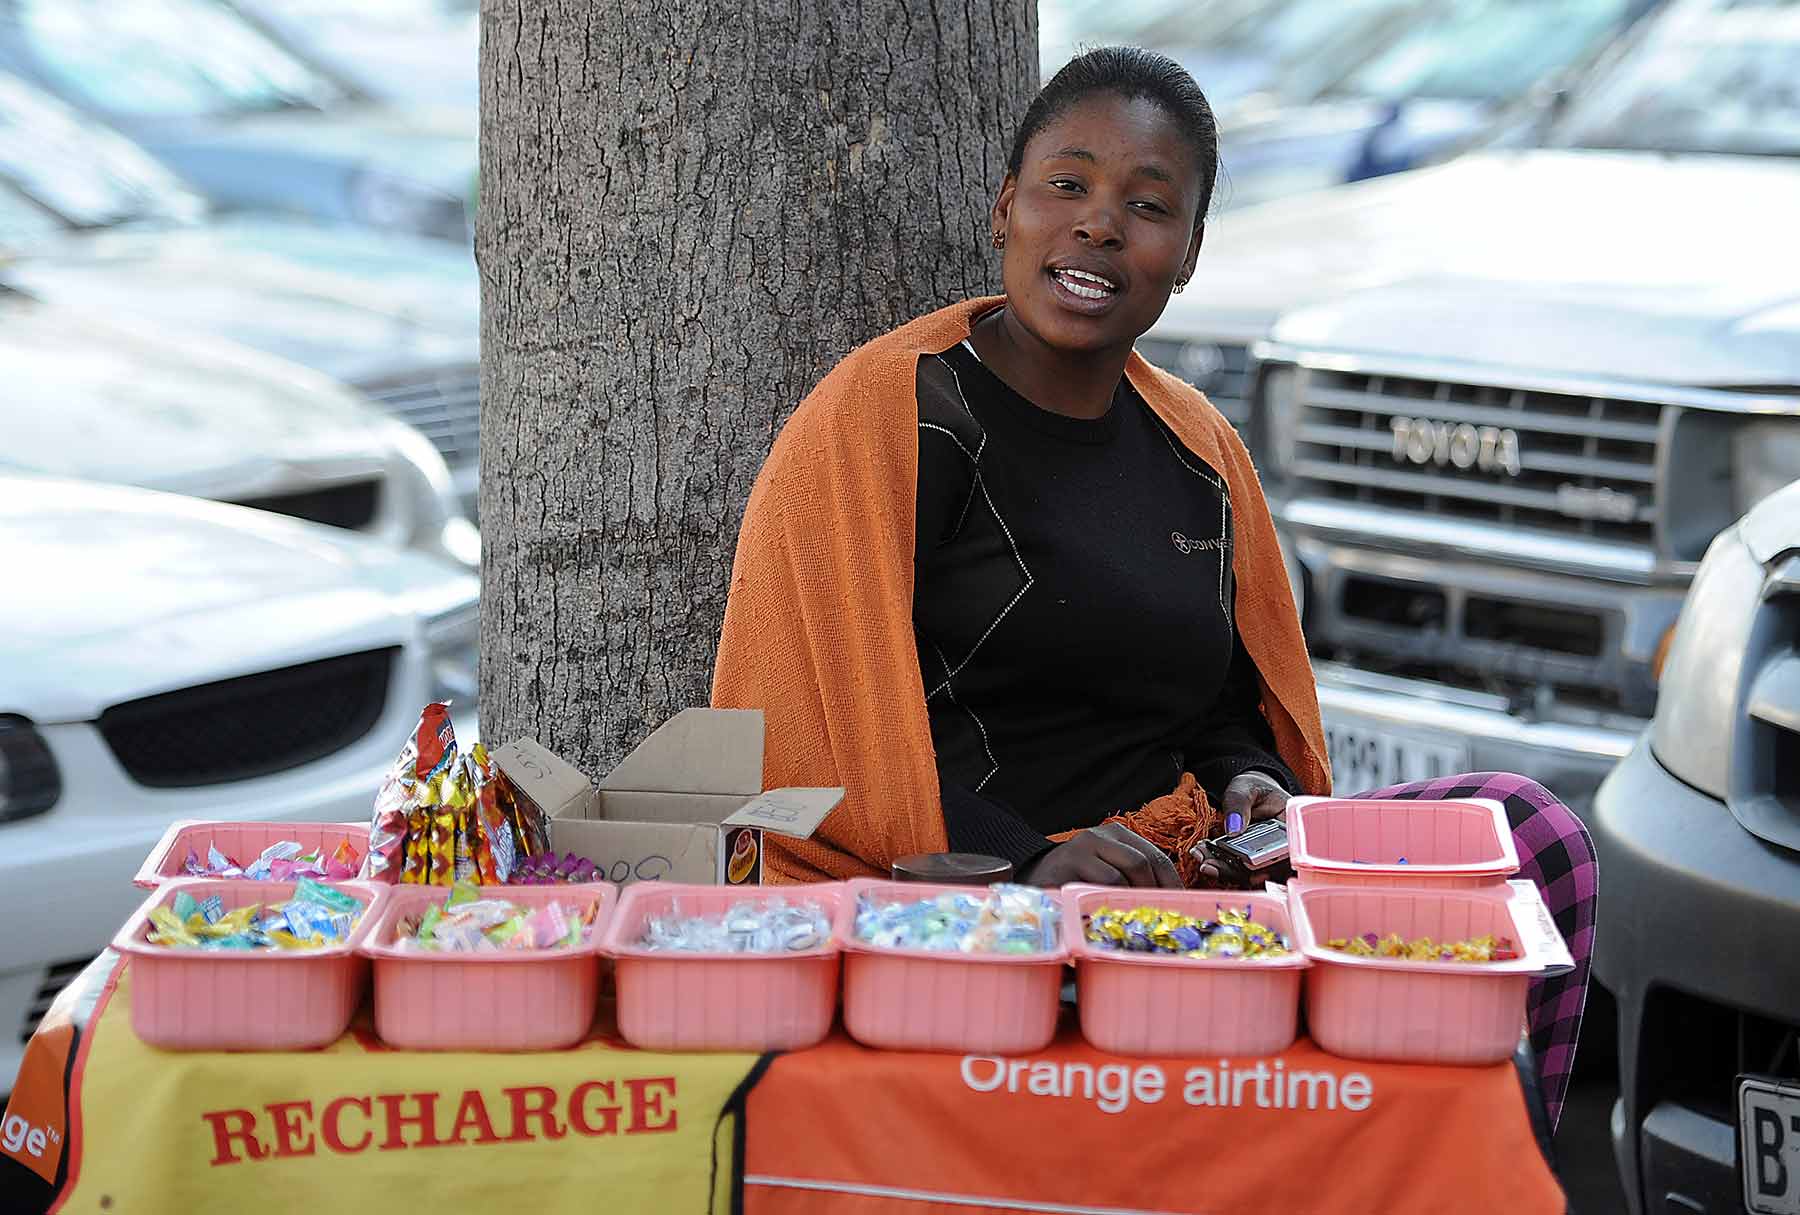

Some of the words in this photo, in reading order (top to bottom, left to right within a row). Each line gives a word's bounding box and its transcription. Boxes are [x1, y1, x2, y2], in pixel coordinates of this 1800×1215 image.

[1389, 417, 1520, 476] TOYOTA
[961, 1055, 1166, 1113] Orange
[1183, 1059, 1374, 1110] airtime
[202, 1078, 678, 1166] RECHARGE
